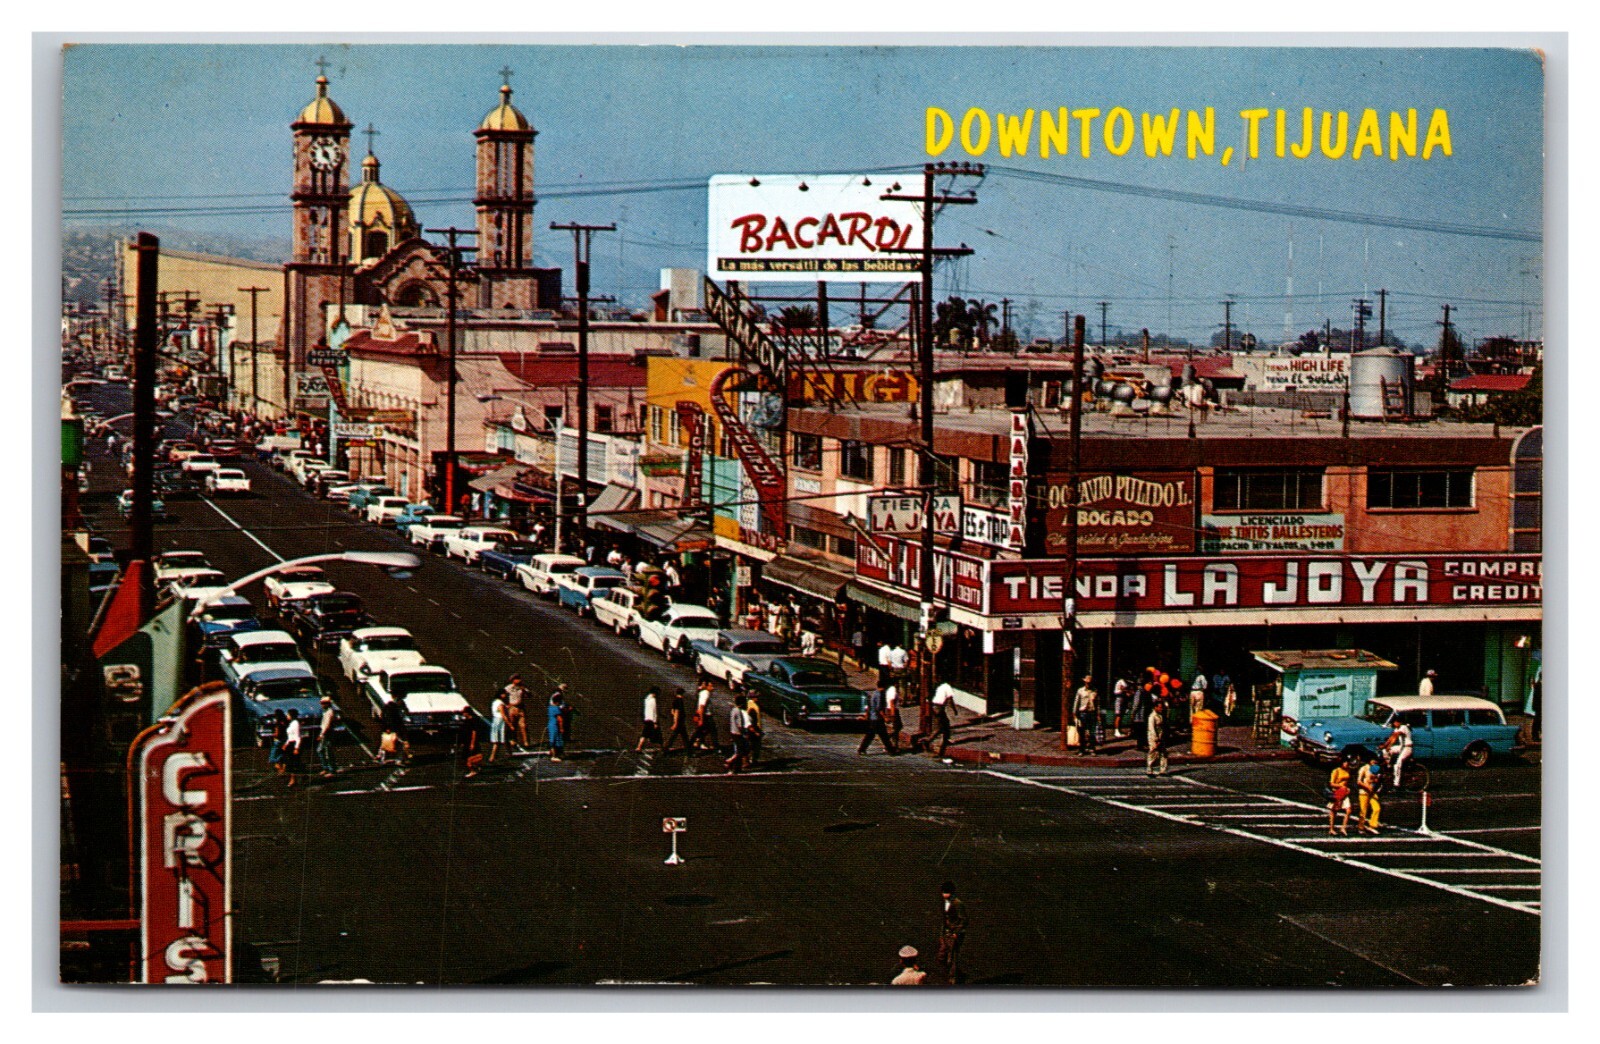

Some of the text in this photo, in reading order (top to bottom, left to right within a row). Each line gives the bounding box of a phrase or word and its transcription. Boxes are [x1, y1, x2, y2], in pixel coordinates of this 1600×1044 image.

[730, 211, 913, 254] BACARDI
[720, 259, 735, 271] La
[739, 259, 765, 271] más
[822, 259, 838, 271] de
[841, 259, 859, 271] las
[705, 282, 787, 387] FARMACIA
[1290, 360, 1317, 372] HIGH
[1320, 360, 1344, 372] LIFE
[1049, 475, 1113, 509] OCAVIO
[1115, 475, 1175, 507] PULIDO
[872, 512, 957, 531] LA JYA
[1240, 516, 1304, 525] LICENCIADO
[1272, 524, 1343, 539] BALLESTEROS
[910, 547, 954, 599] JYA
[1003, 561, 1429, 607] TIENDA LA JOYA
